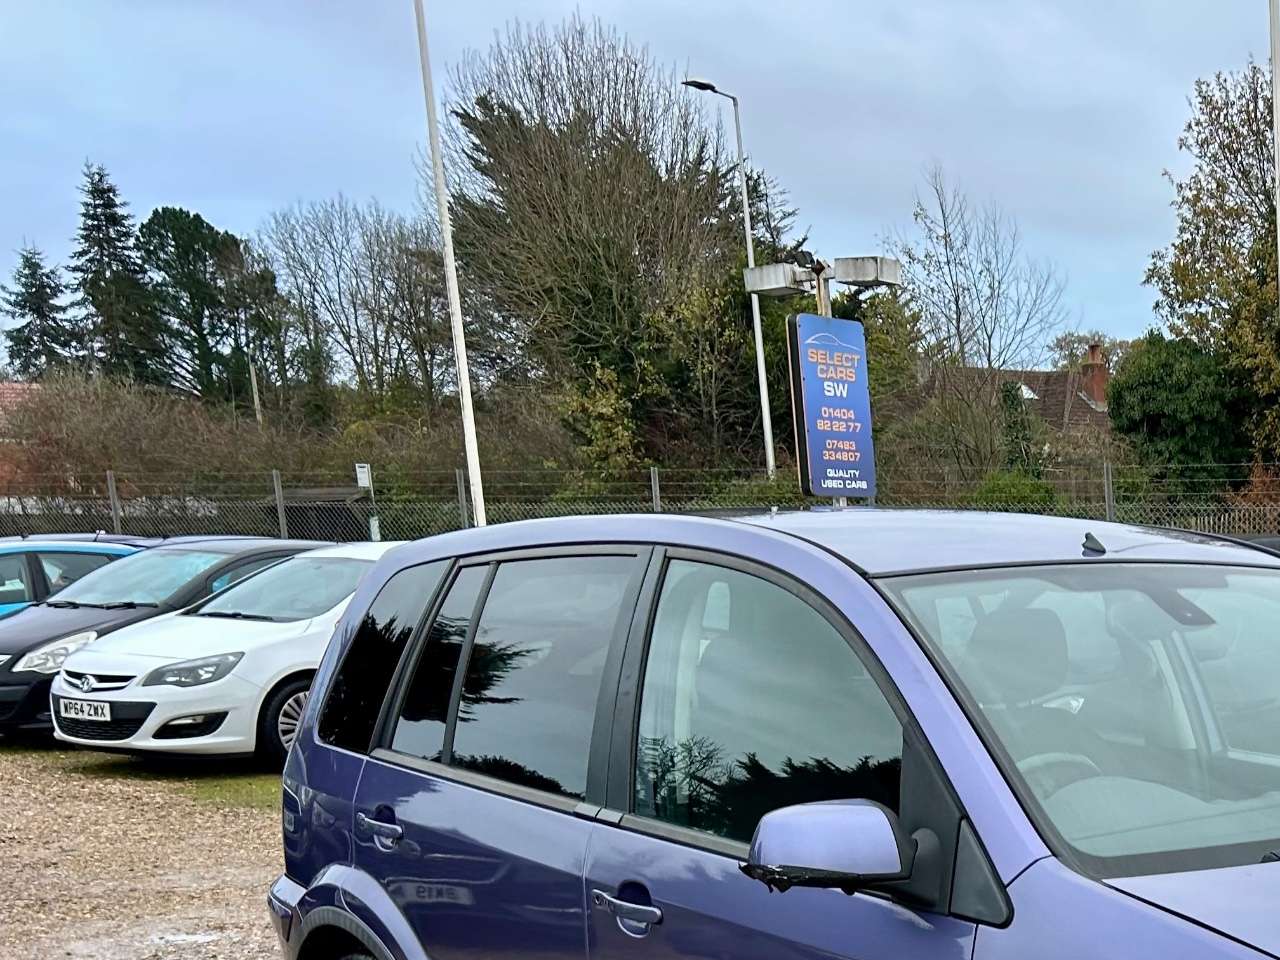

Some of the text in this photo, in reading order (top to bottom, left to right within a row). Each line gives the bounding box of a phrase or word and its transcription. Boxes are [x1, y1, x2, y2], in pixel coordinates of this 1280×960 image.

[808, 349, 861, 368] SELECT
[817, 364, 856, 382] CARS
[823, 381, 848, 398] SW
[821, 407, 855, 420] 01404
[822, 450, 861, 462] 334807
[826, 468, 860, 478] QUALITY
[821, 479, 868, 489] USED CARS
[63, 700, 84, 716] WP64
